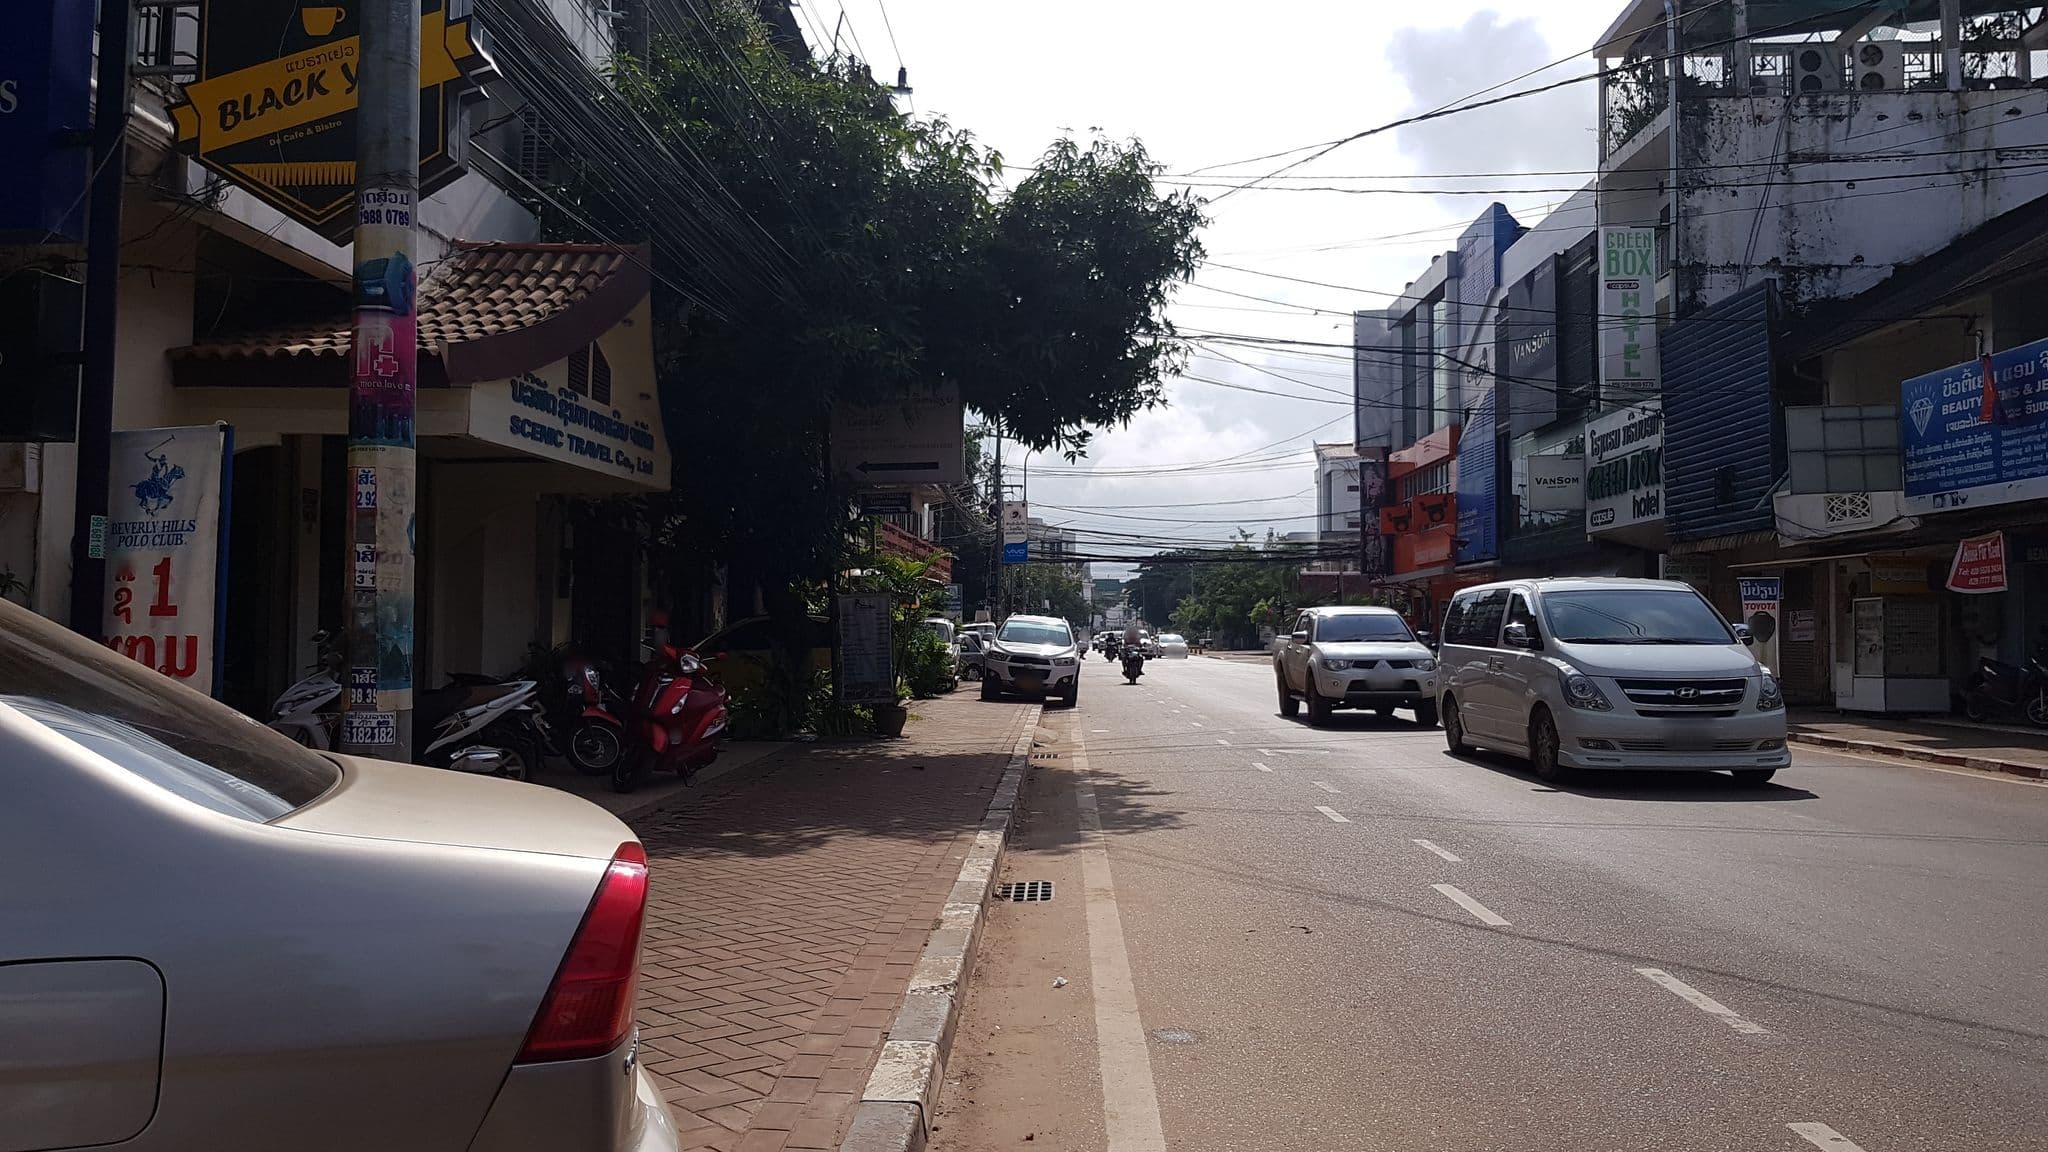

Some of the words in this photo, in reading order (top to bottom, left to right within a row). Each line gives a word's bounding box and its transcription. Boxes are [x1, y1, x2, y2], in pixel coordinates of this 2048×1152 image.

[218, 68, 330, 132] BLACK
[306, 128, 314, 137] &
[314, 119, 343, 134] Bistro
[385, 208, 409, 227] 0789
[1606, 231, 1651, 249] GREEN
[1606, 249, 1651, 276] BOX
[1941, 396, 1984, 415] BEAUTY
[2022, 383, 2033, 396] &
[510, 414, 564, 448] SCENIC
[566, 433, 614, 464] TRAVEL
[1586, 457, 1628, 501] GREEN
[1632, 489, 1660, 519] hotel
[111, 520, 159, 535] BEVERLY
[162, 519, 196, 532] HILLS
[117, 534, 149, 547] POLO
[149, 556, 178, 617] 1
[1744, 602, 1776, 610] TOYOTA
